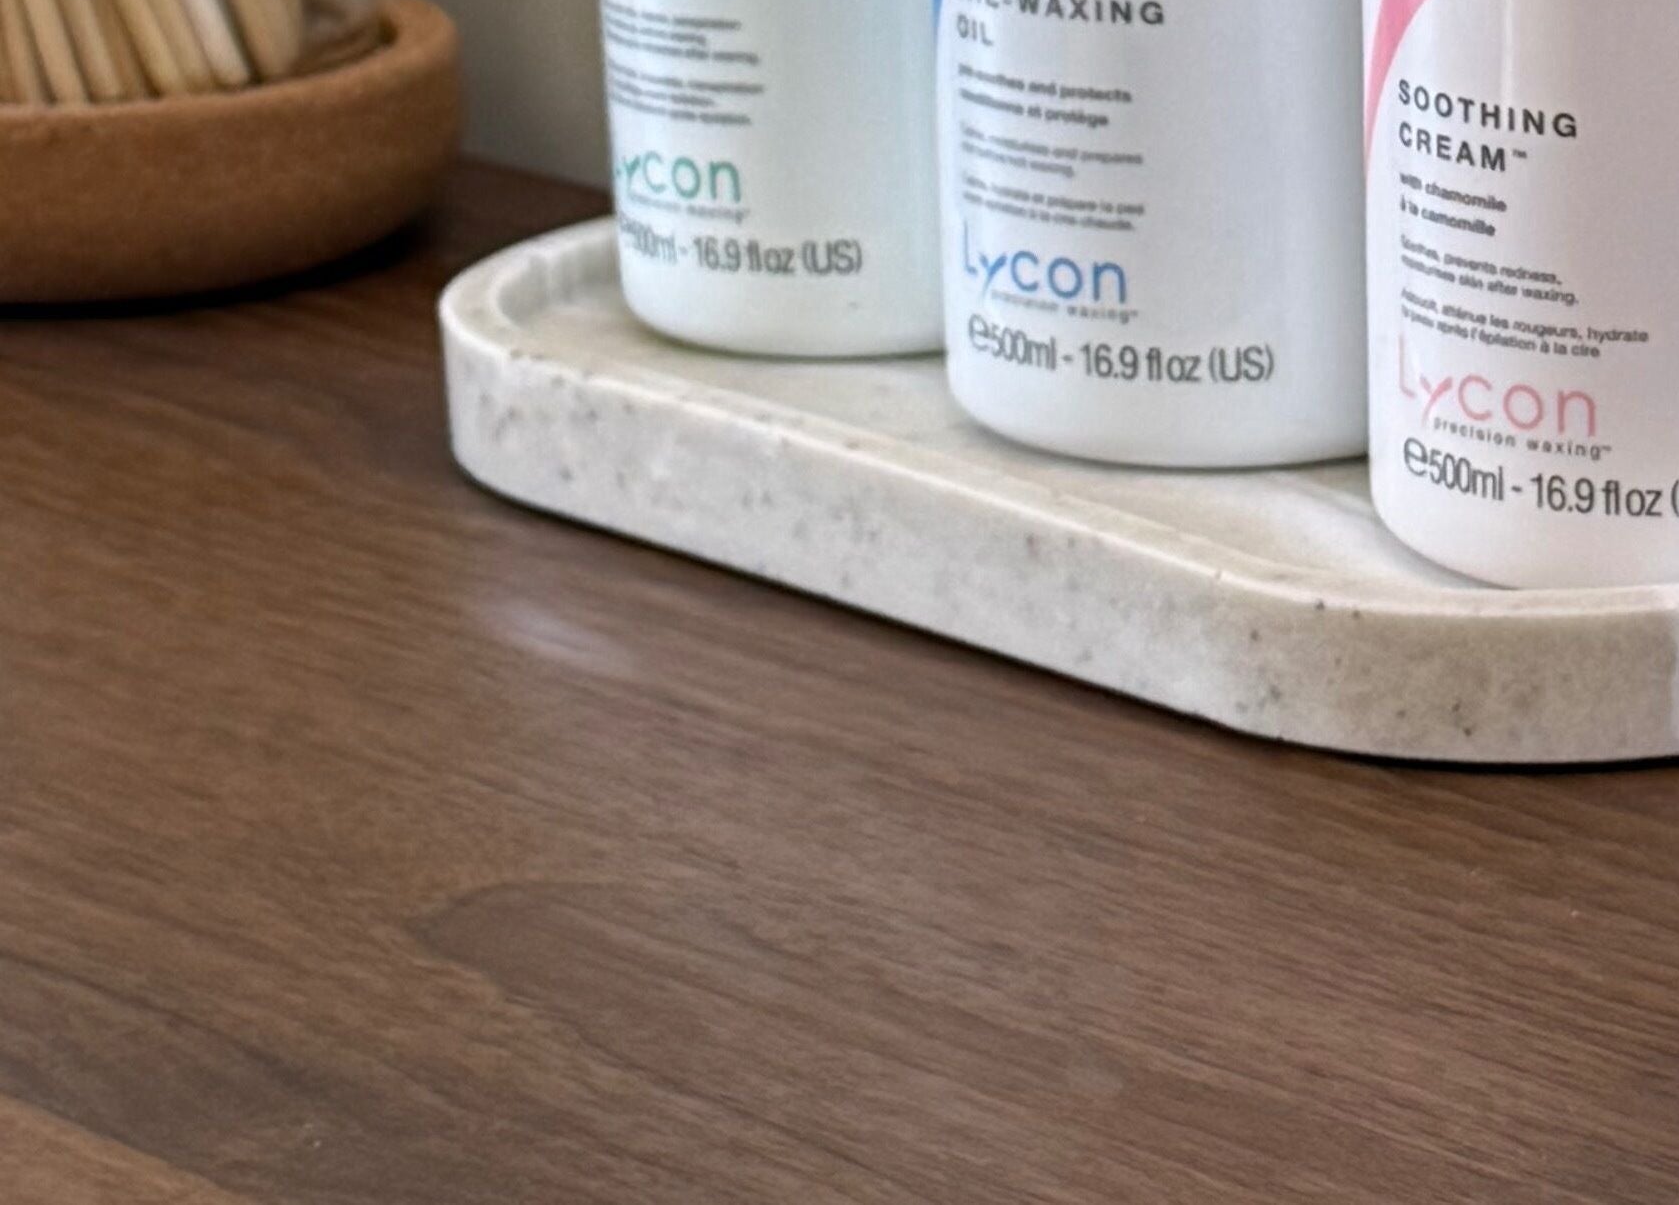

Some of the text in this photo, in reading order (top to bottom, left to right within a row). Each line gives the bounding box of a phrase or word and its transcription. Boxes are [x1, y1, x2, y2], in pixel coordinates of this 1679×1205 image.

[957, 14, 994, 46] OIL
[1398, 78, 1577, 138] SOOTHING
[615, 151, 741, 204] ycon
[1425, 181, 1508, 213] chamomile
[1421, 207, 1496, 237] camomille
[693, 236, 742, 272] 16.9
[764, 246, 796, 275] oz
[802, 238, 864, 276] (US)
[963, 220, 1127, 304] Lycon
[1486, 279, 1518, 296] after
[1520, 287, 1580, 307] waxing.
[1553, 341, 1568, 356] la
[1570, 344, 1601, 359] cire
[1587, 325, 1650, 345] hydrate
[1080, 342, 1139, 380] 16.9
[1165, 354, 1202, 383] oz
[1208, 344, 1275, 383] (US)
[1398, 332, 1597, 438] Lycon
[1432, 415, 1517, 448] precision
[1530, 472, 1596, 515] 16.9
[1625, 488, 1663, 517] oz
